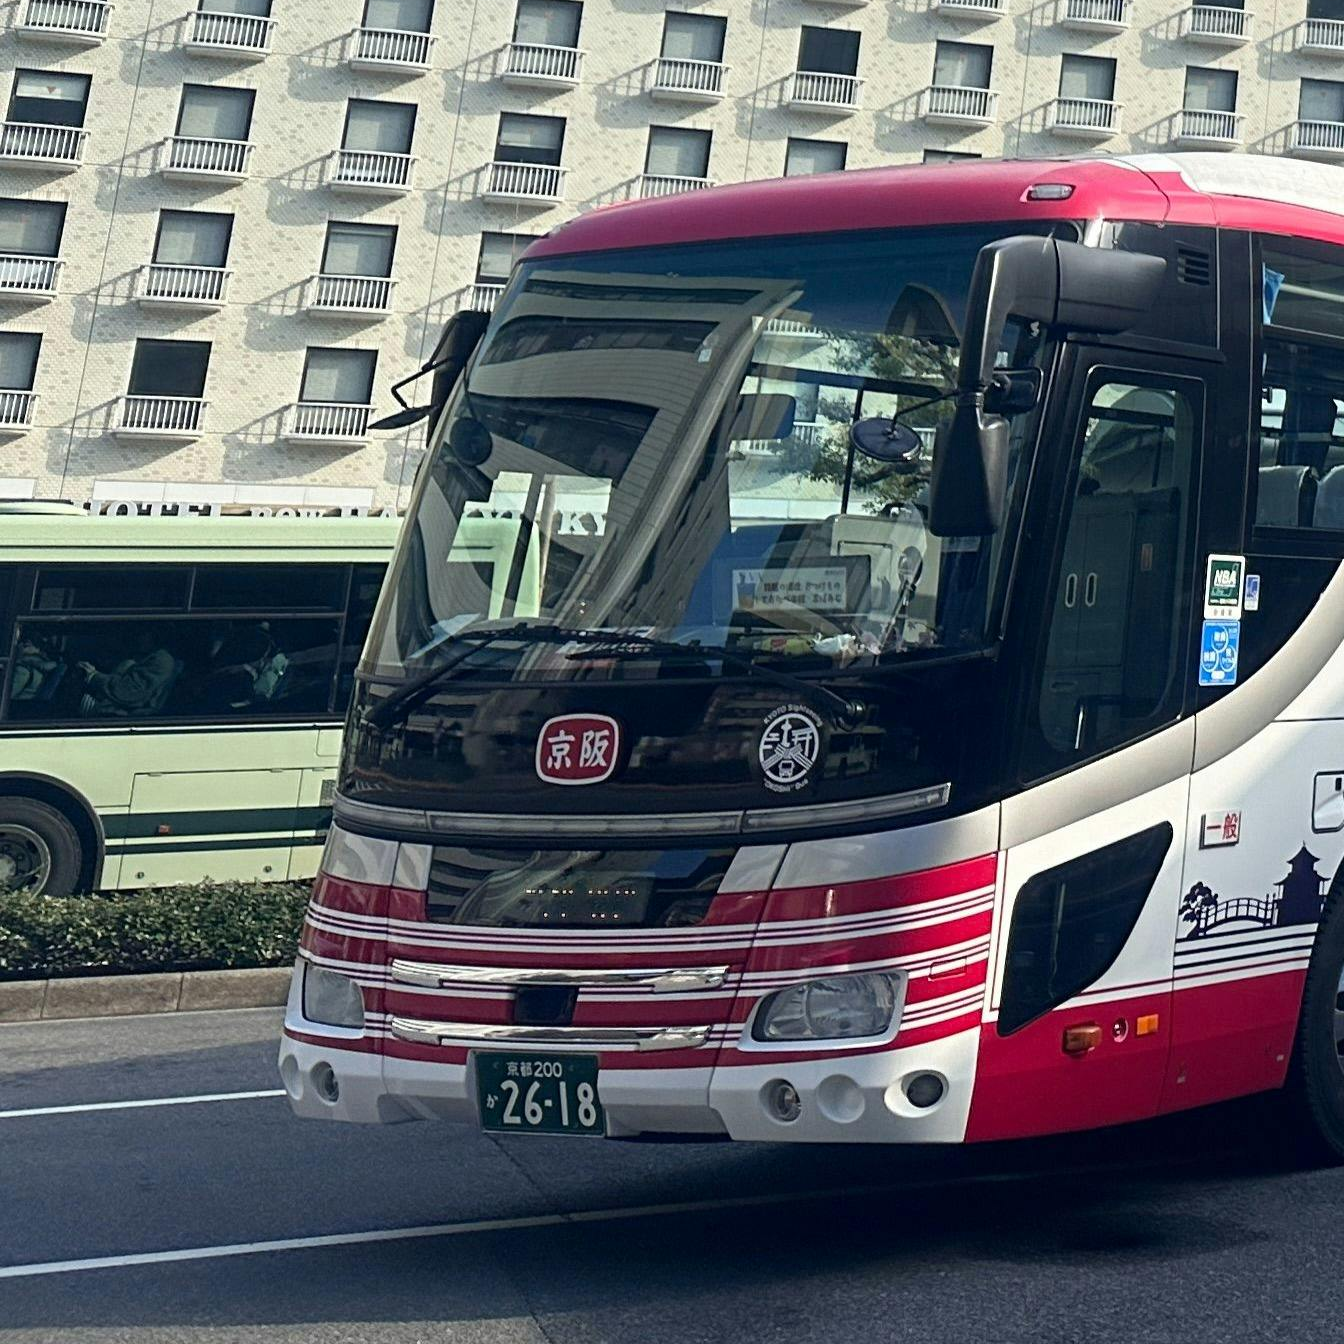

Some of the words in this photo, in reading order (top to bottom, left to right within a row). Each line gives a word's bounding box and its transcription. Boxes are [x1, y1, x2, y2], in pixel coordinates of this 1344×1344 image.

[547, 729, 610, 770] 京阪
[1206, 813, 1239, 840] 一般
[500, 1079, 597, 1127] 26-18
